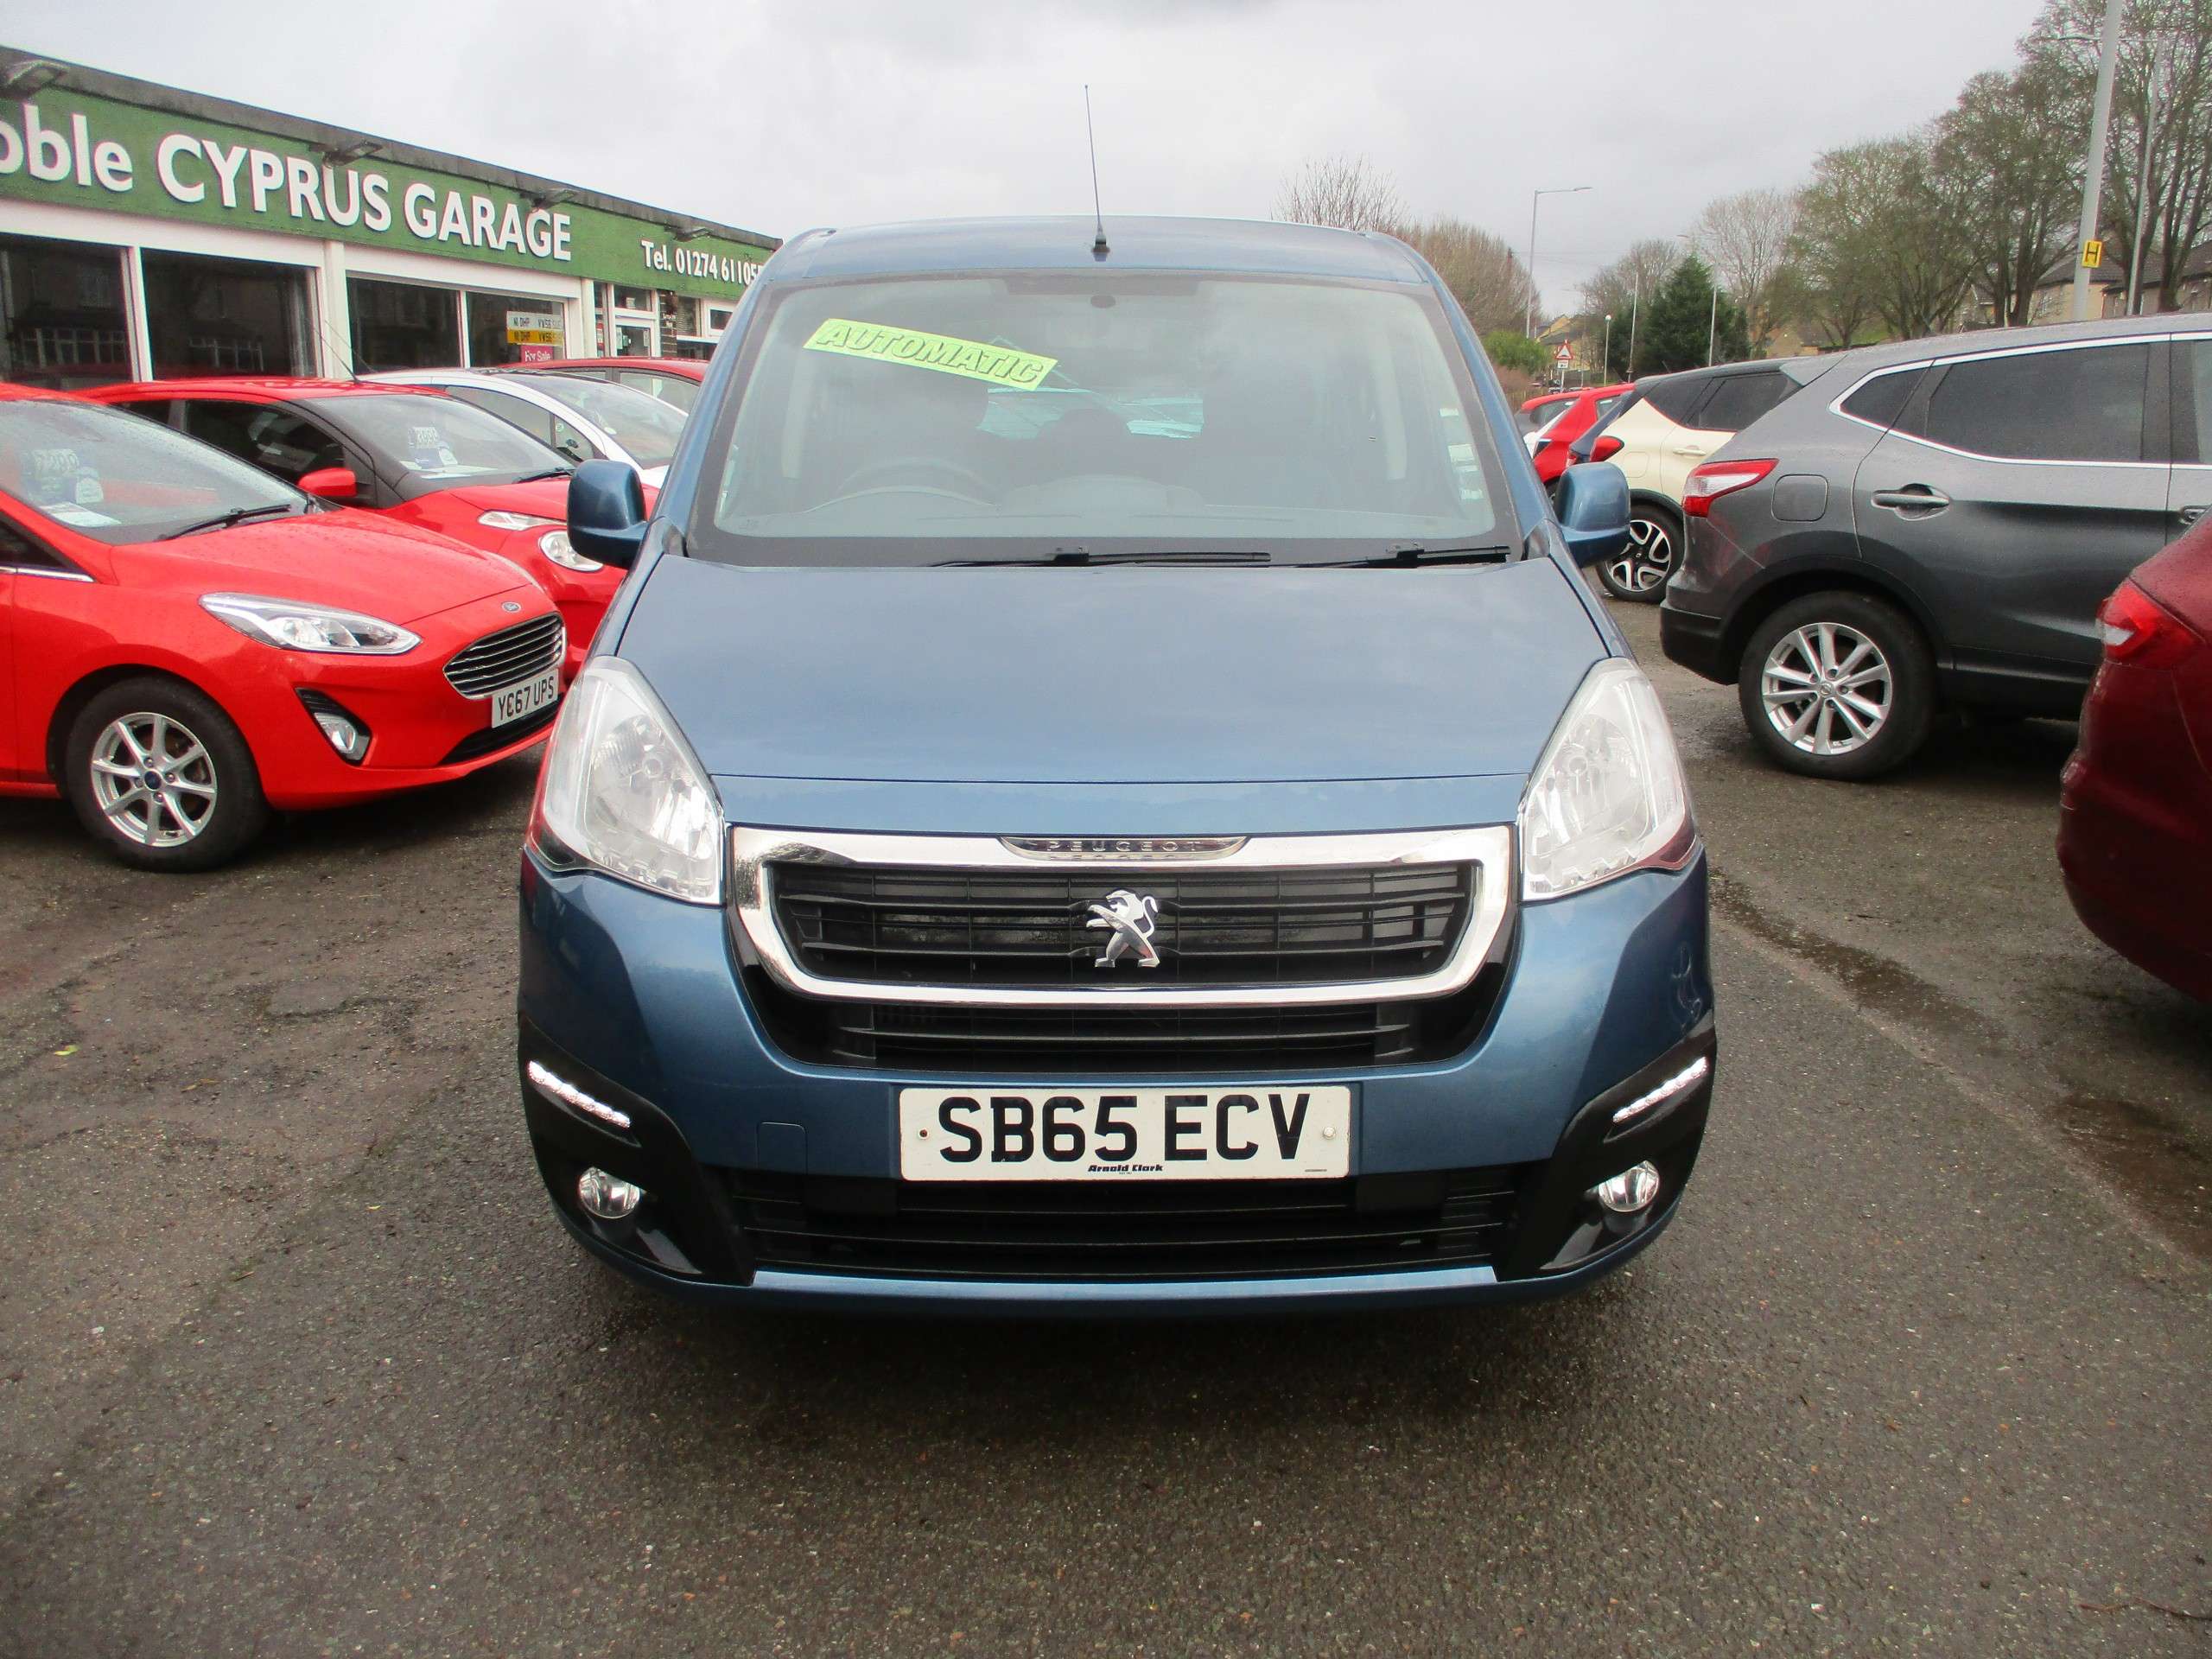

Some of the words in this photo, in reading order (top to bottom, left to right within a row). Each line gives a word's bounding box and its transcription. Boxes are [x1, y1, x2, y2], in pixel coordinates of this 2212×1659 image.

[157, 133, 392, 232] CYPRUS
[404, 182, 571, 261] GARAGE
[641, 239, 672, 271] Tel.
[676, 247, 718, 280] 01274
[2085, 241, 2100, 264] H
[537, 350, 551, 362] Sale
[817, 324, 1043, 383] AUTOMATIC
[498, 685, 531, 721] YC67
[533, 676, 554, 706] UPS
[1046, 841, 1201, 852] PEUGEOT
[938, 1096, 1138, 1163] SB65
[1164, 1093, 1311, 1161] ECV
[1088, 1164, 1129, 1173] Arnold
